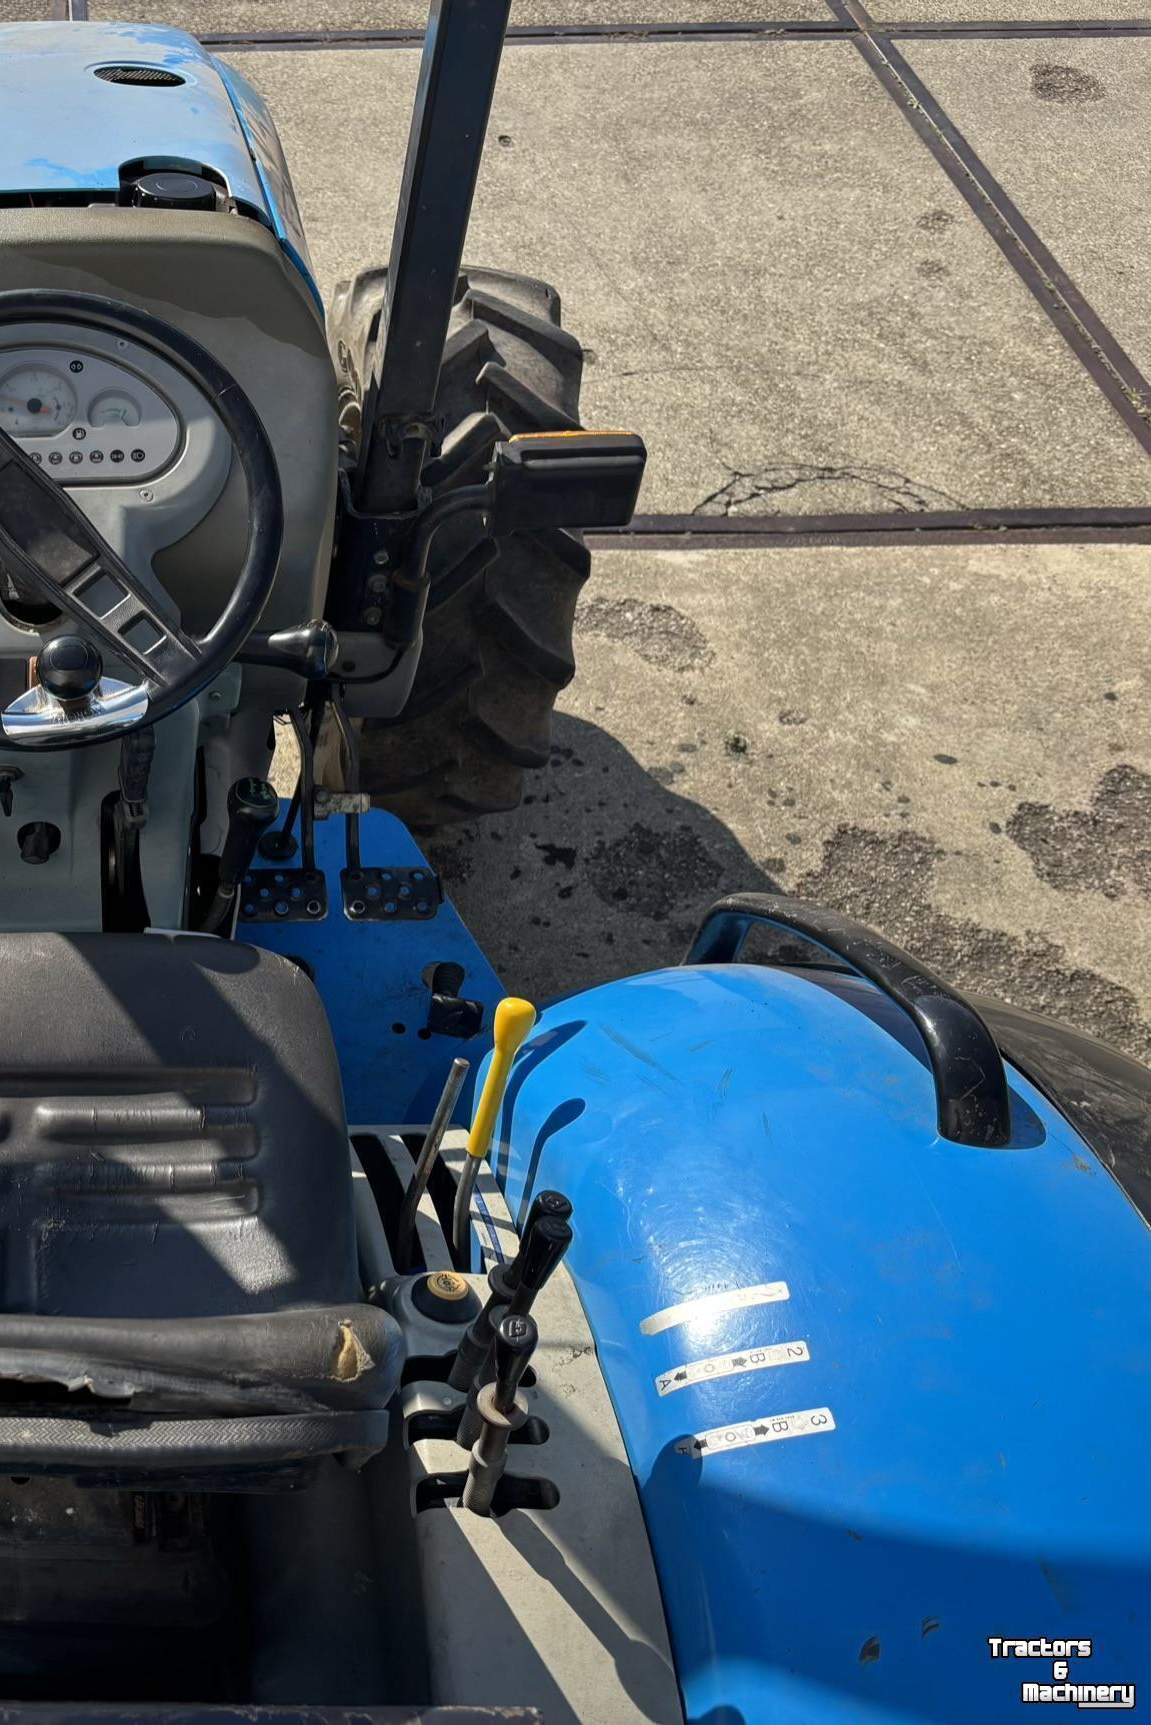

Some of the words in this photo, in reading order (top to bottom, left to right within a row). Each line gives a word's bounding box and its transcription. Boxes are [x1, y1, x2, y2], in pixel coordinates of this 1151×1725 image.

[749, 1352, 766, 1364] B
[786, 1346, 804, 1357] 2
[771, 1420, 789, 1433] B
[810, 1413, 828, 1426] 3
